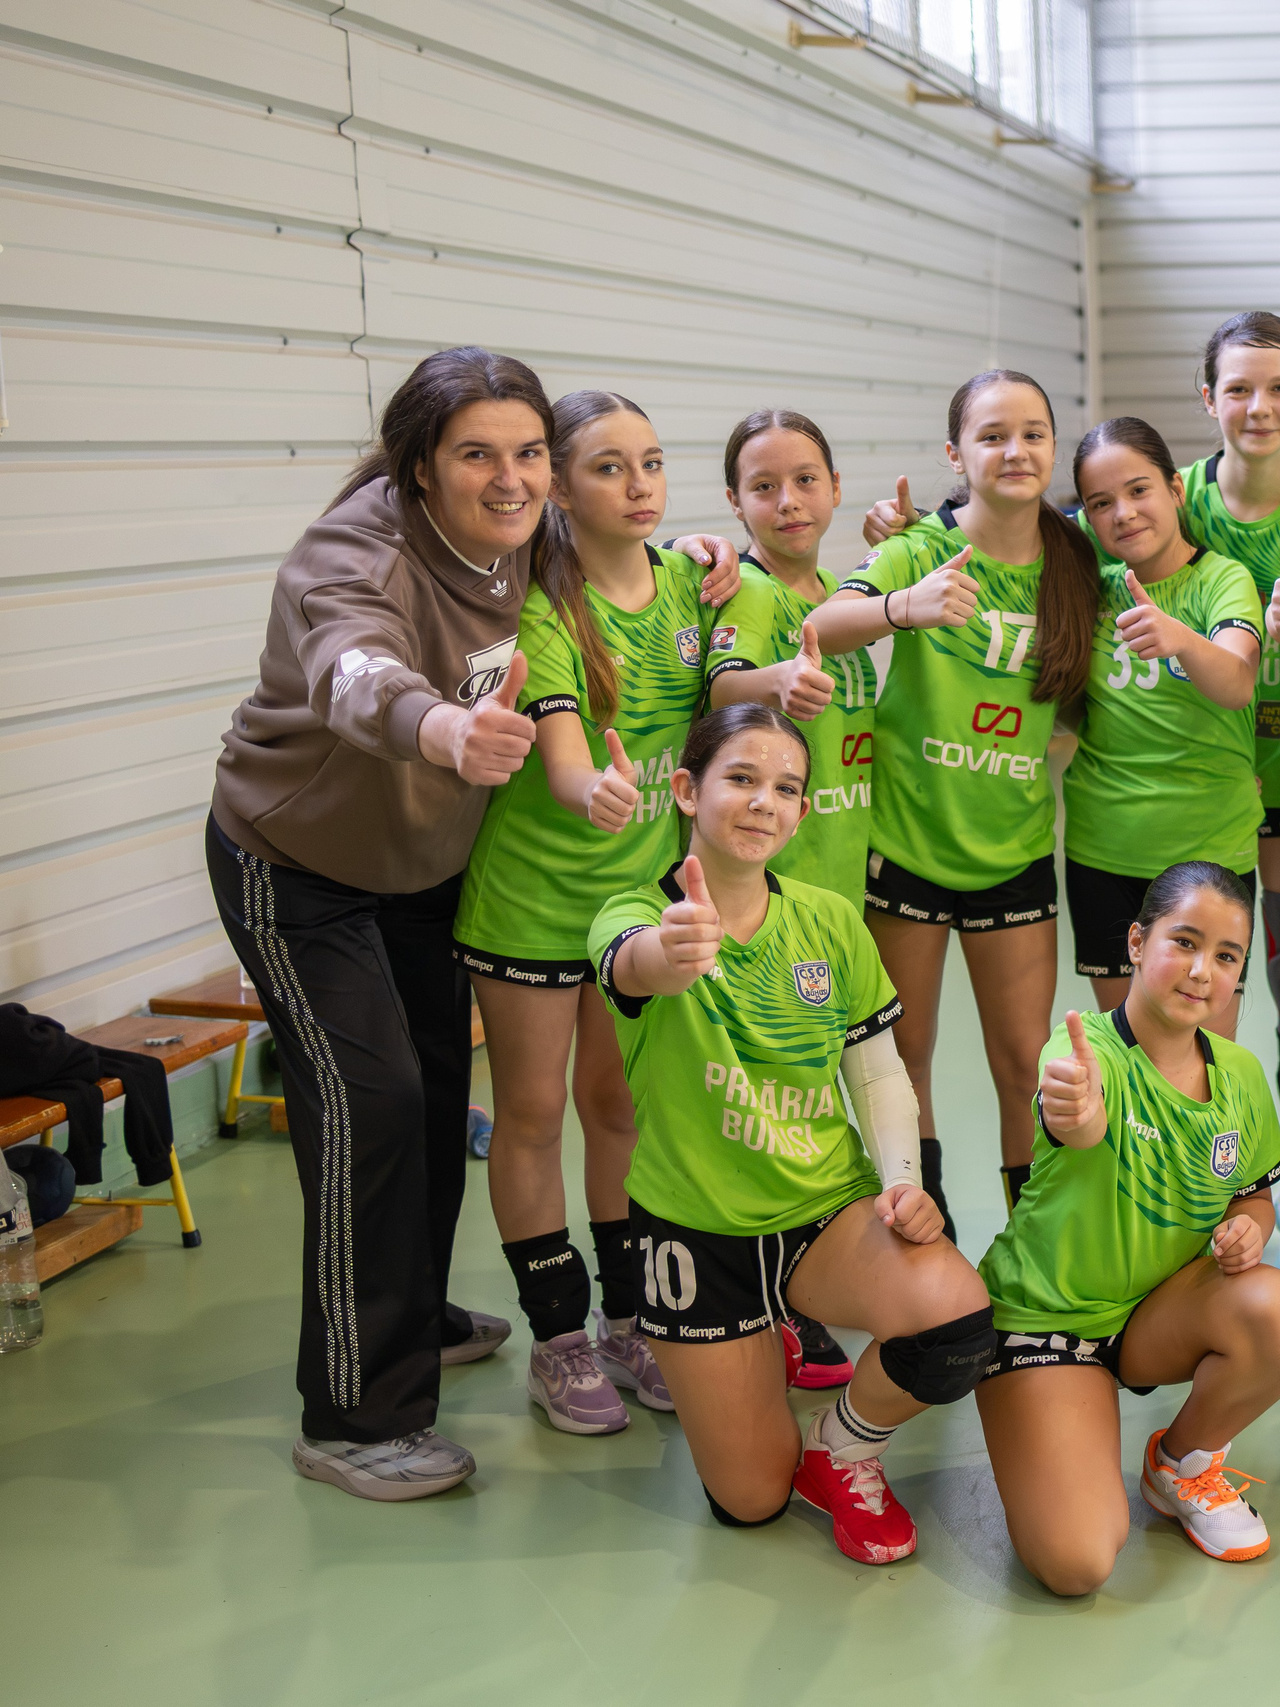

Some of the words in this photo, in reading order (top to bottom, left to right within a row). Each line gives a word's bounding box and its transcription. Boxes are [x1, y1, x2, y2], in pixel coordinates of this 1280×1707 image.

[982, 610, 1037, 673] 17
[899, 903, 930, 920] Kempa
[1004, 909, 1042, 923] Kempa
[963, 918, 994, 929] Kempa
[463, 954, 494, 973] Kempa
[1078, 963, 1108, 975] Kempa
[505, 967, 547, 984] Kempa
[799, 966, 826, 979] CSO
[1219, 1137, 1236, 1151] CSO
[528, 1250, 573, 1272] Kempa
[639, 1235, 697, 1311] 10
[640, 1316, 668, 1336] Kempa
[738, 1314, 768, 1333] Kemp
[679, 1325, 726, 1340] Kempa
[946, 1347, 991, 1366] Kempa
[1012, 1354, 1060, 1367] Kempa
